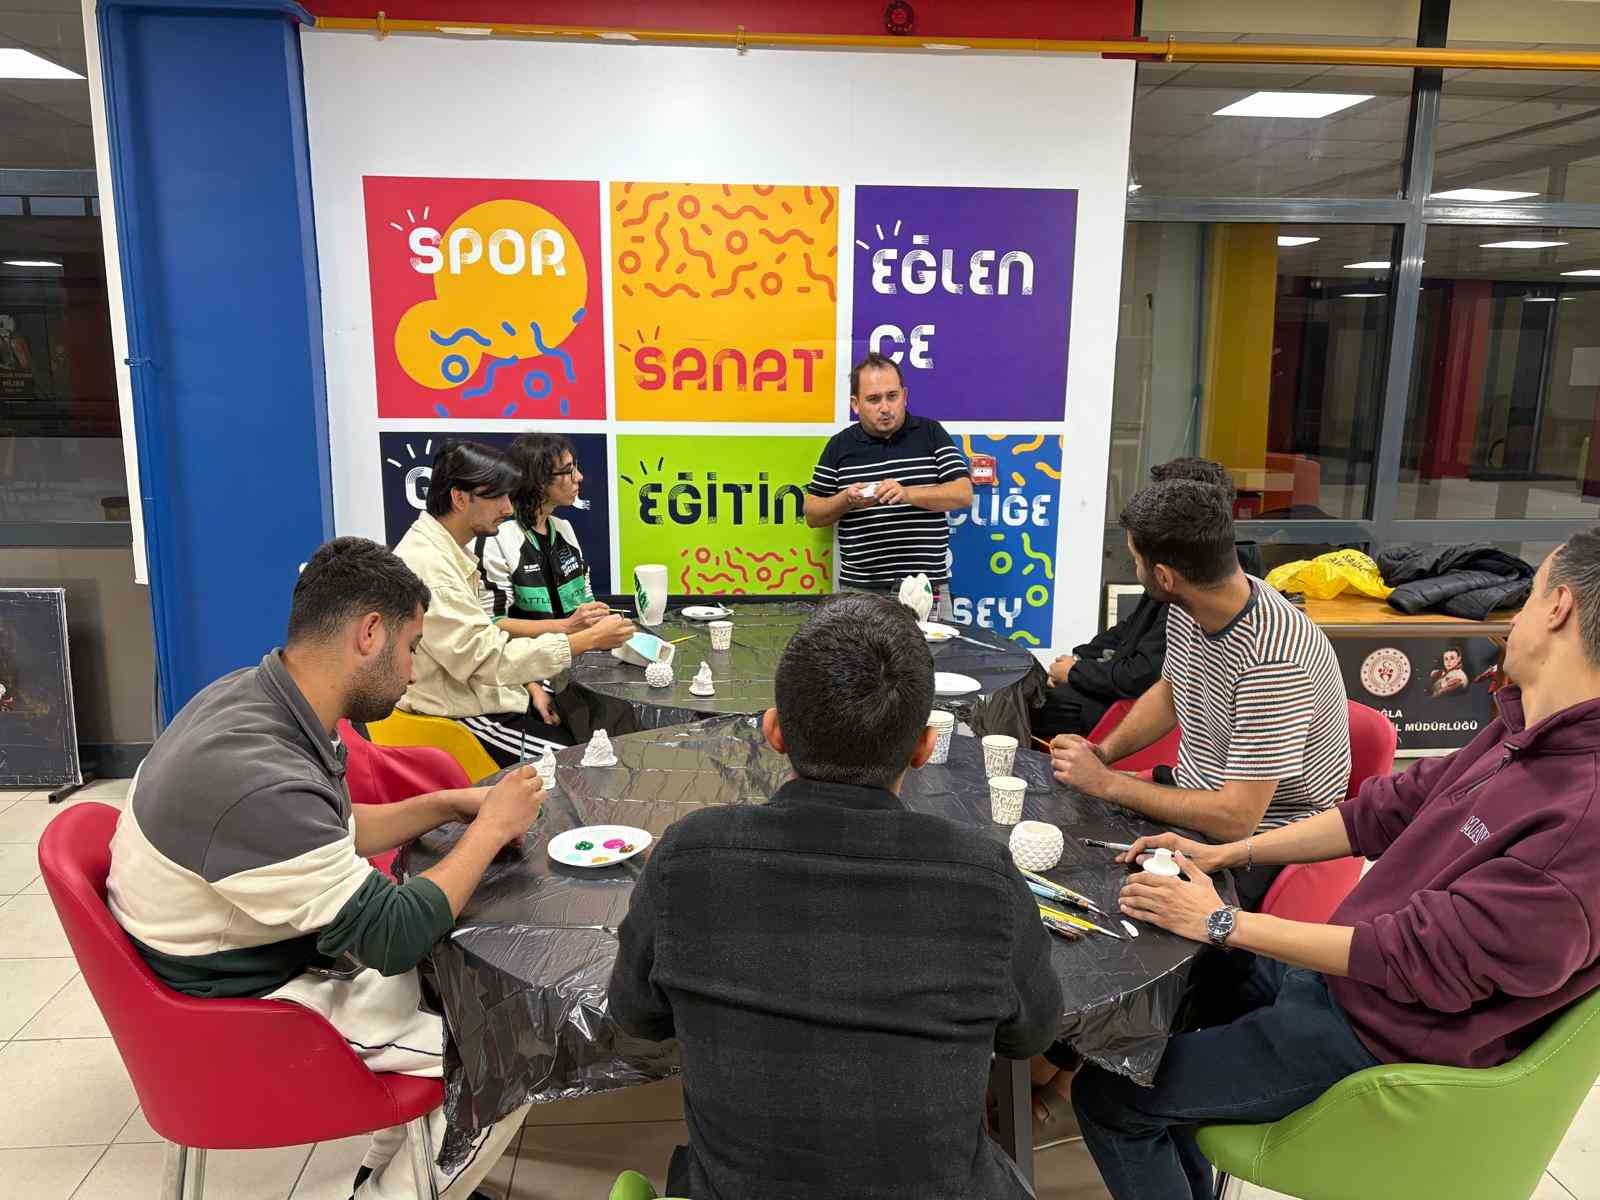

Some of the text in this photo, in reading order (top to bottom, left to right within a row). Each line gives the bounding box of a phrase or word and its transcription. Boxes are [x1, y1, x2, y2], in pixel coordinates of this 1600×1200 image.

[408, 227, 566, 276] SPOR
[872, 234, 1034, 295] EĞLEN
[634, 346, 824, 392] SANAT
[869, 324, 935, 369] CE
[1405, 720, 1478, 731] MÜDÜRLÜĞÜ
